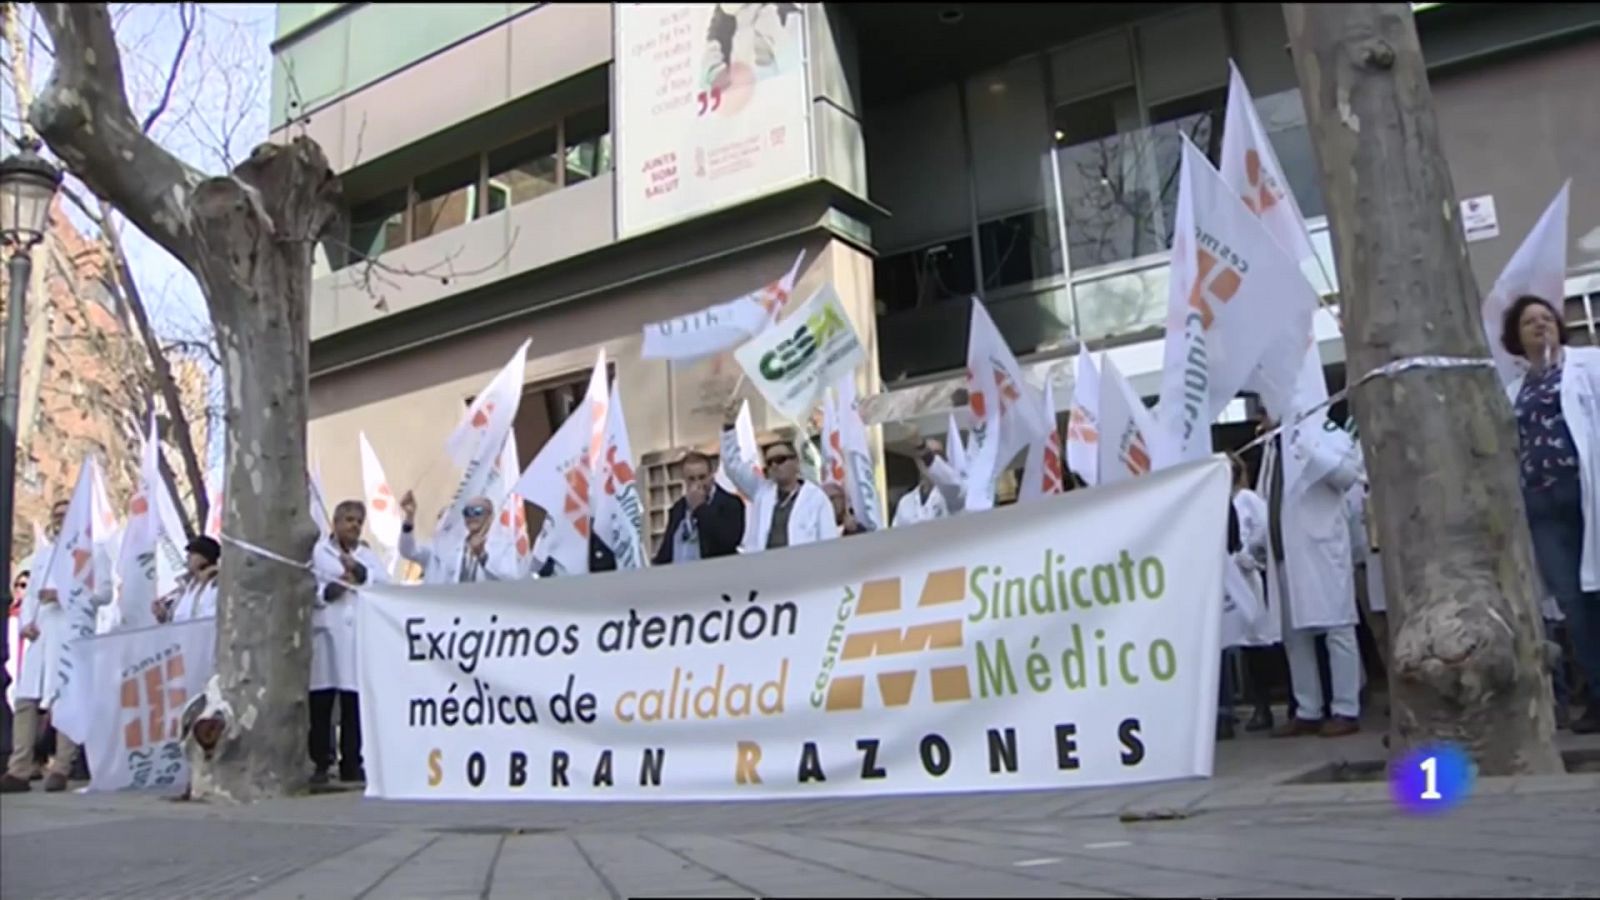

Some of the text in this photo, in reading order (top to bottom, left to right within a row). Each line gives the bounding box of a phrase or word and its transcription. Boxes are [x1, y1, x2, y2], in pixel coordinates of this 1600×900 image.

[641, 152, 677, 173] JUNTS
[645, 178, 679, 199] SALUT
[651, 166, 677, 182] SOM
[968, 549, 1166, 623] Sindicato
[406, 614, 580, 674] Exigimos
[810, 586, 856, 710] cesmcv
[974, 623, 1178, 699] Médico
[408, 658, 789, 727] médica de calidad
[427, 717, 1146, 788] SOBRAN RAZONES
